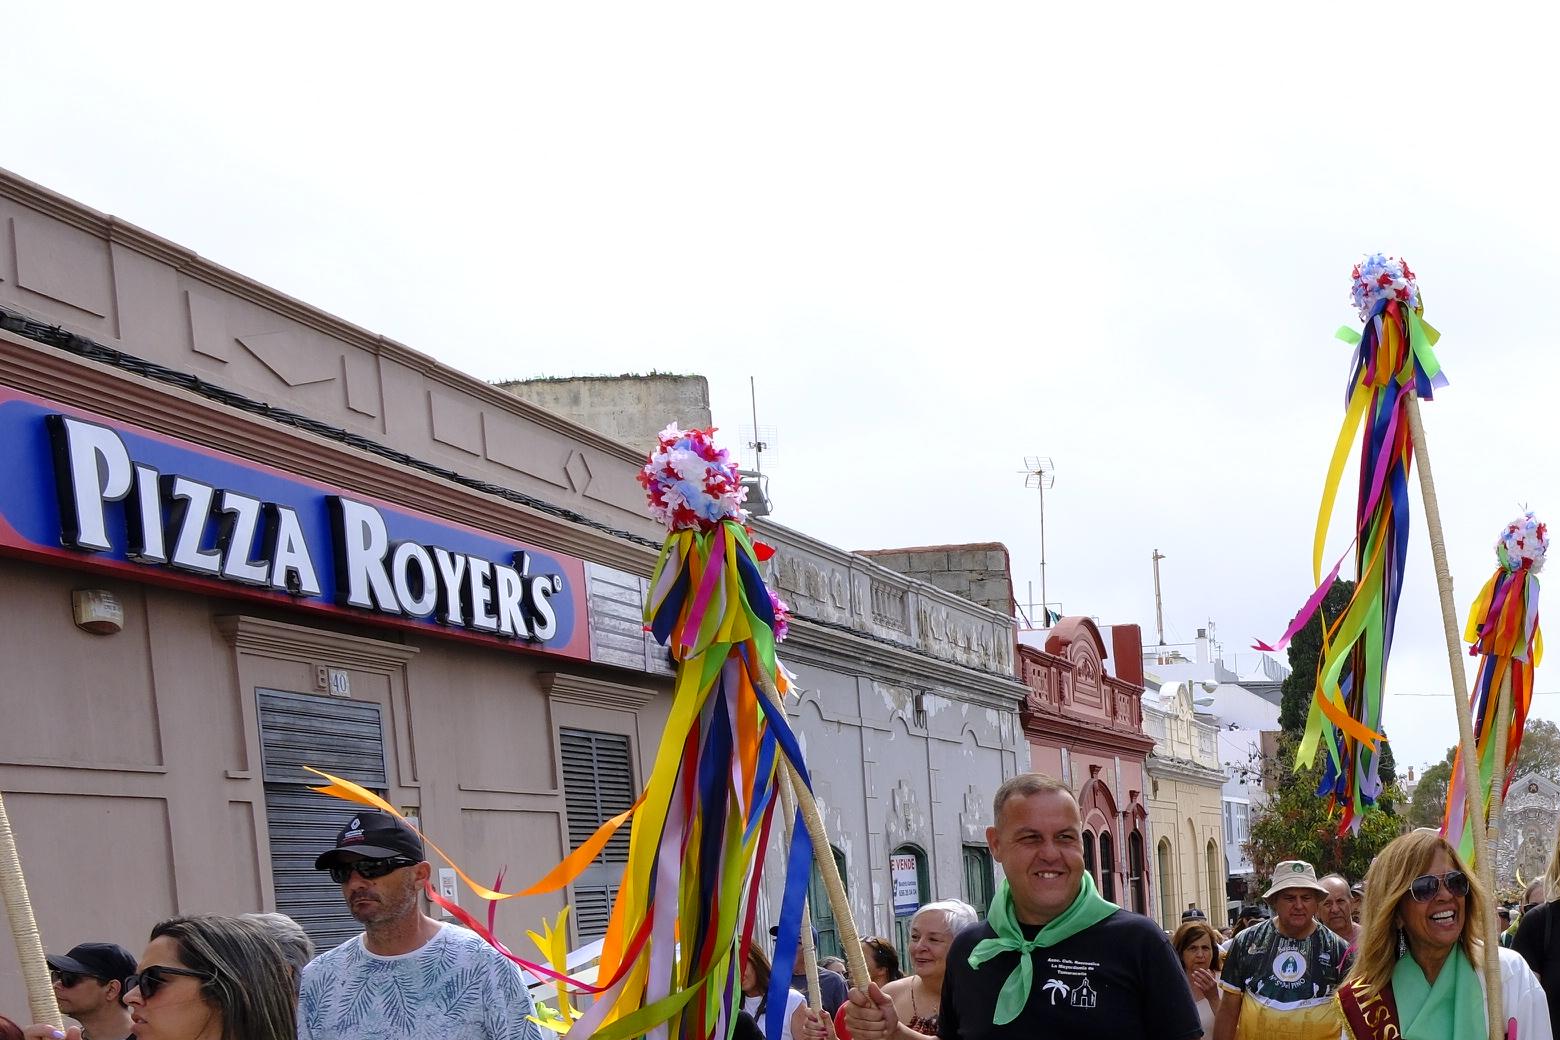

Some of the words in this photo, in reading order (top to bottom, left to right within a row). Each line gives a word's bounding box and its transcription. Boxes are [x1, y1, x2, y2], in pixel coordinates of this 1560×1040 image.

[62, 413, 322, 597] PIZZA
[333, 673, 347, 692] 40
[896, 858, 915, 870] VENDE
